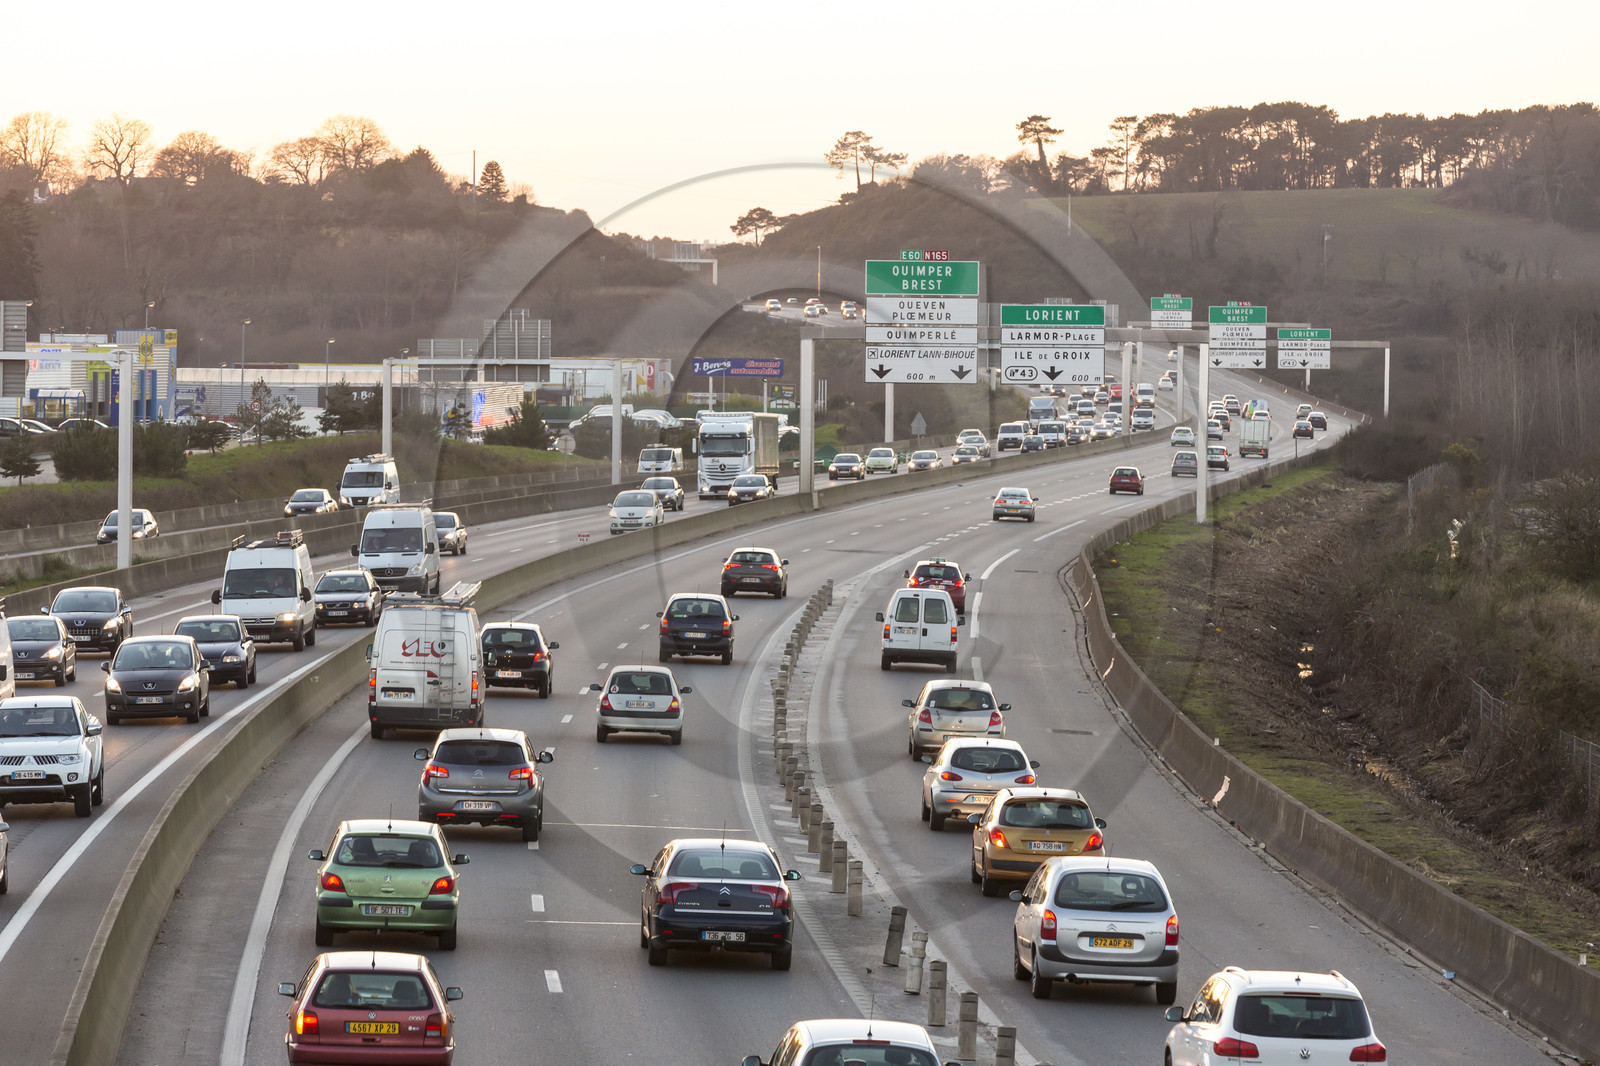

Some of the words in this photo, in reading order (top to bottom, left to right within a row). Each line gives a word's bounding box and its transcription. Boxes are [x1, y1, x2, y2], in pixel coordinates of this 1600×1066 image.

[892, 265, 953, 277] QUIMPER
[902, 279, 943, 290] BREST
[898, 300, 946, 310] QUEVEN
[892, 311, 952, 321] PLŒMEUR
[1025, 309, 1081, 321] LORIENT
[886, 329, 957, 340] QUIMPERLÉ
[1290, 330, 1319, 338] LORIENT
[880, 349, 917, 359] LORIENT
[917, 349, 976, 360] LANN-BIHOUÉ
[1014, 351, 1033, 360] ILE
[1054, 351, 1091, 360] GROIX
[745, 360, 781, 368] discount
[730, 367, 781, 376] automobiles
[1019, 368, 1034, 378] 43
[906, 373, 924, 381] 600
[1071, 374, 1090, 382] 600
[252, 402, 260, 411] 50
[380, 906, 393, 914] 507
[706, 931, 719, 940] 736
[735, 932, 744, 941] 56
[1093, 937, 1108, 946] 572
[1123, 939, 1133, 948] 29
[352, 1023, 372, 1033] 4567
[374, 1023, 384, 1033] XP
[386, 1024, 396, 1033] 29
